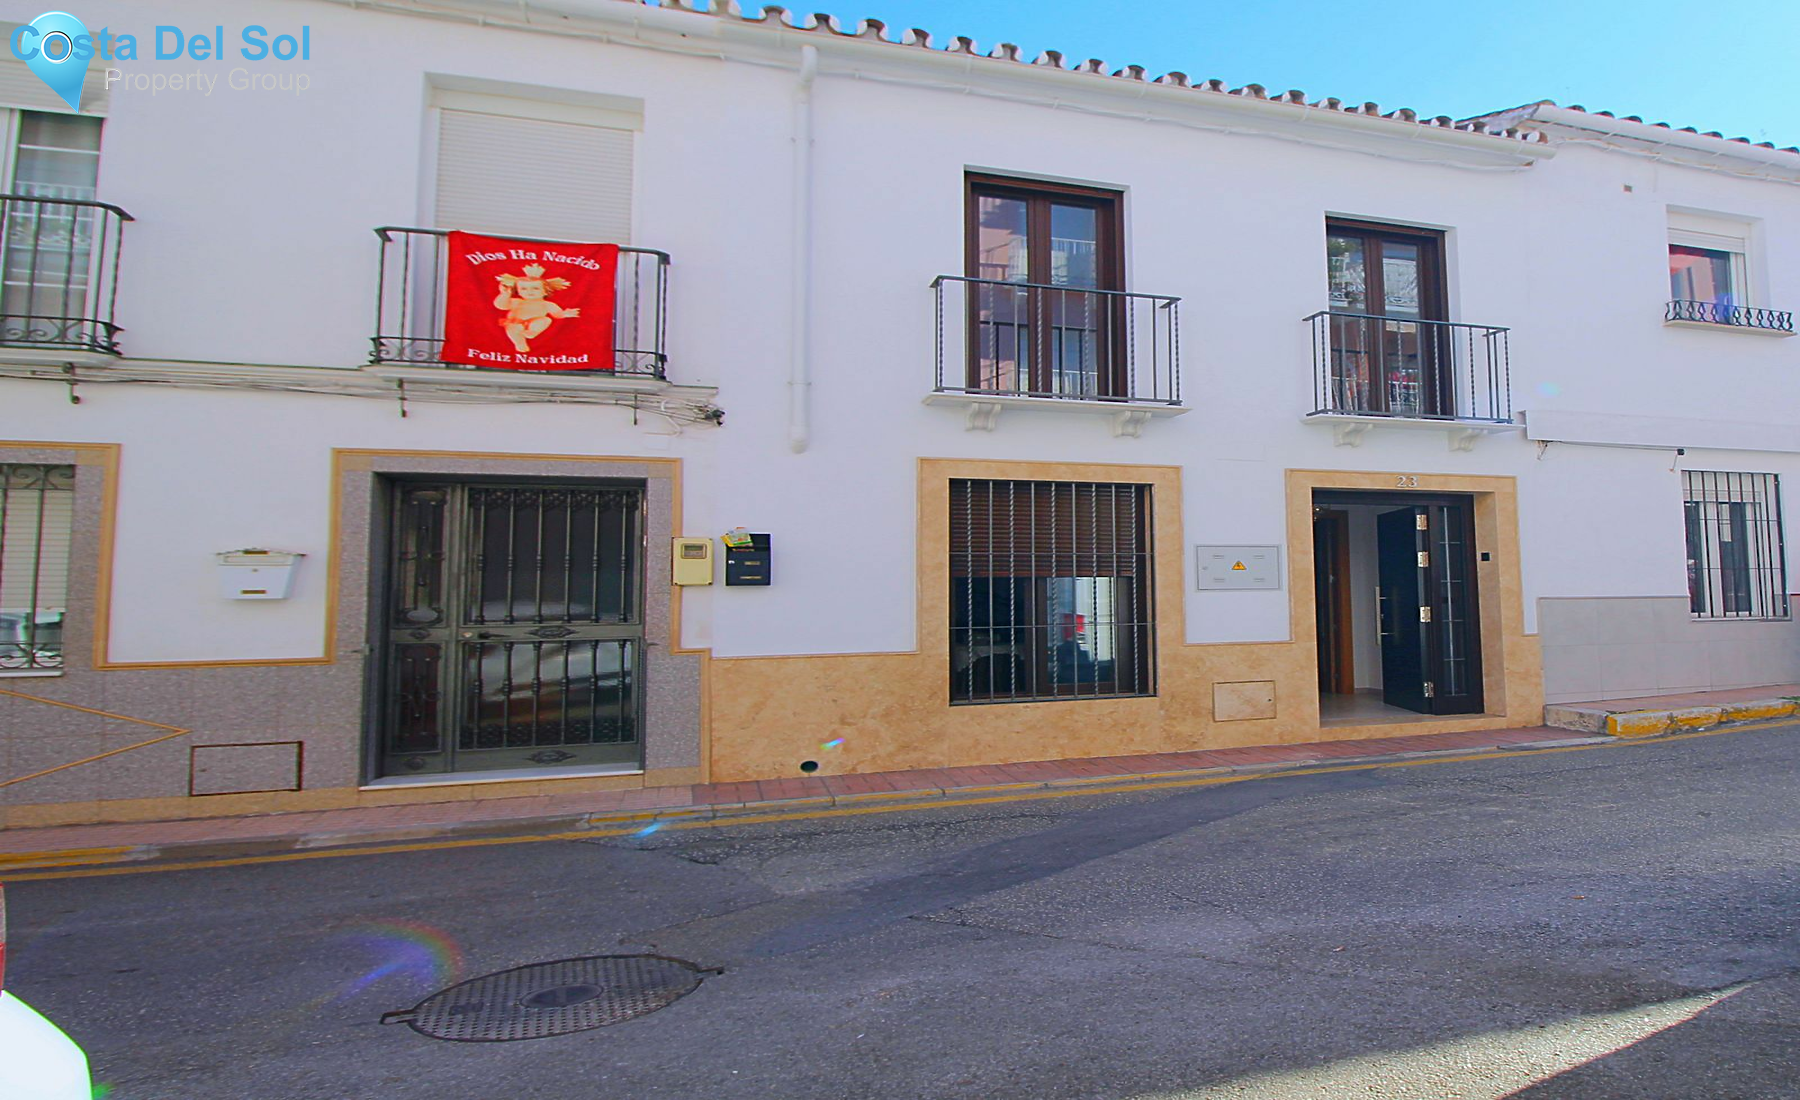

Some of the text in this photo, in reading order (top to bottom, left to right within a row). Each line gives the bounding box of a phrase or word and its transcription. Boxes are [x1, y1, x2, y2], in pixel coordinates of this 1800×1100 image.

[465, 249, 601, 271] Dios Ha Nacido
[467, 348, 589, 364] Feliz Navidad
[1396, 475, 1418, 488] 23
